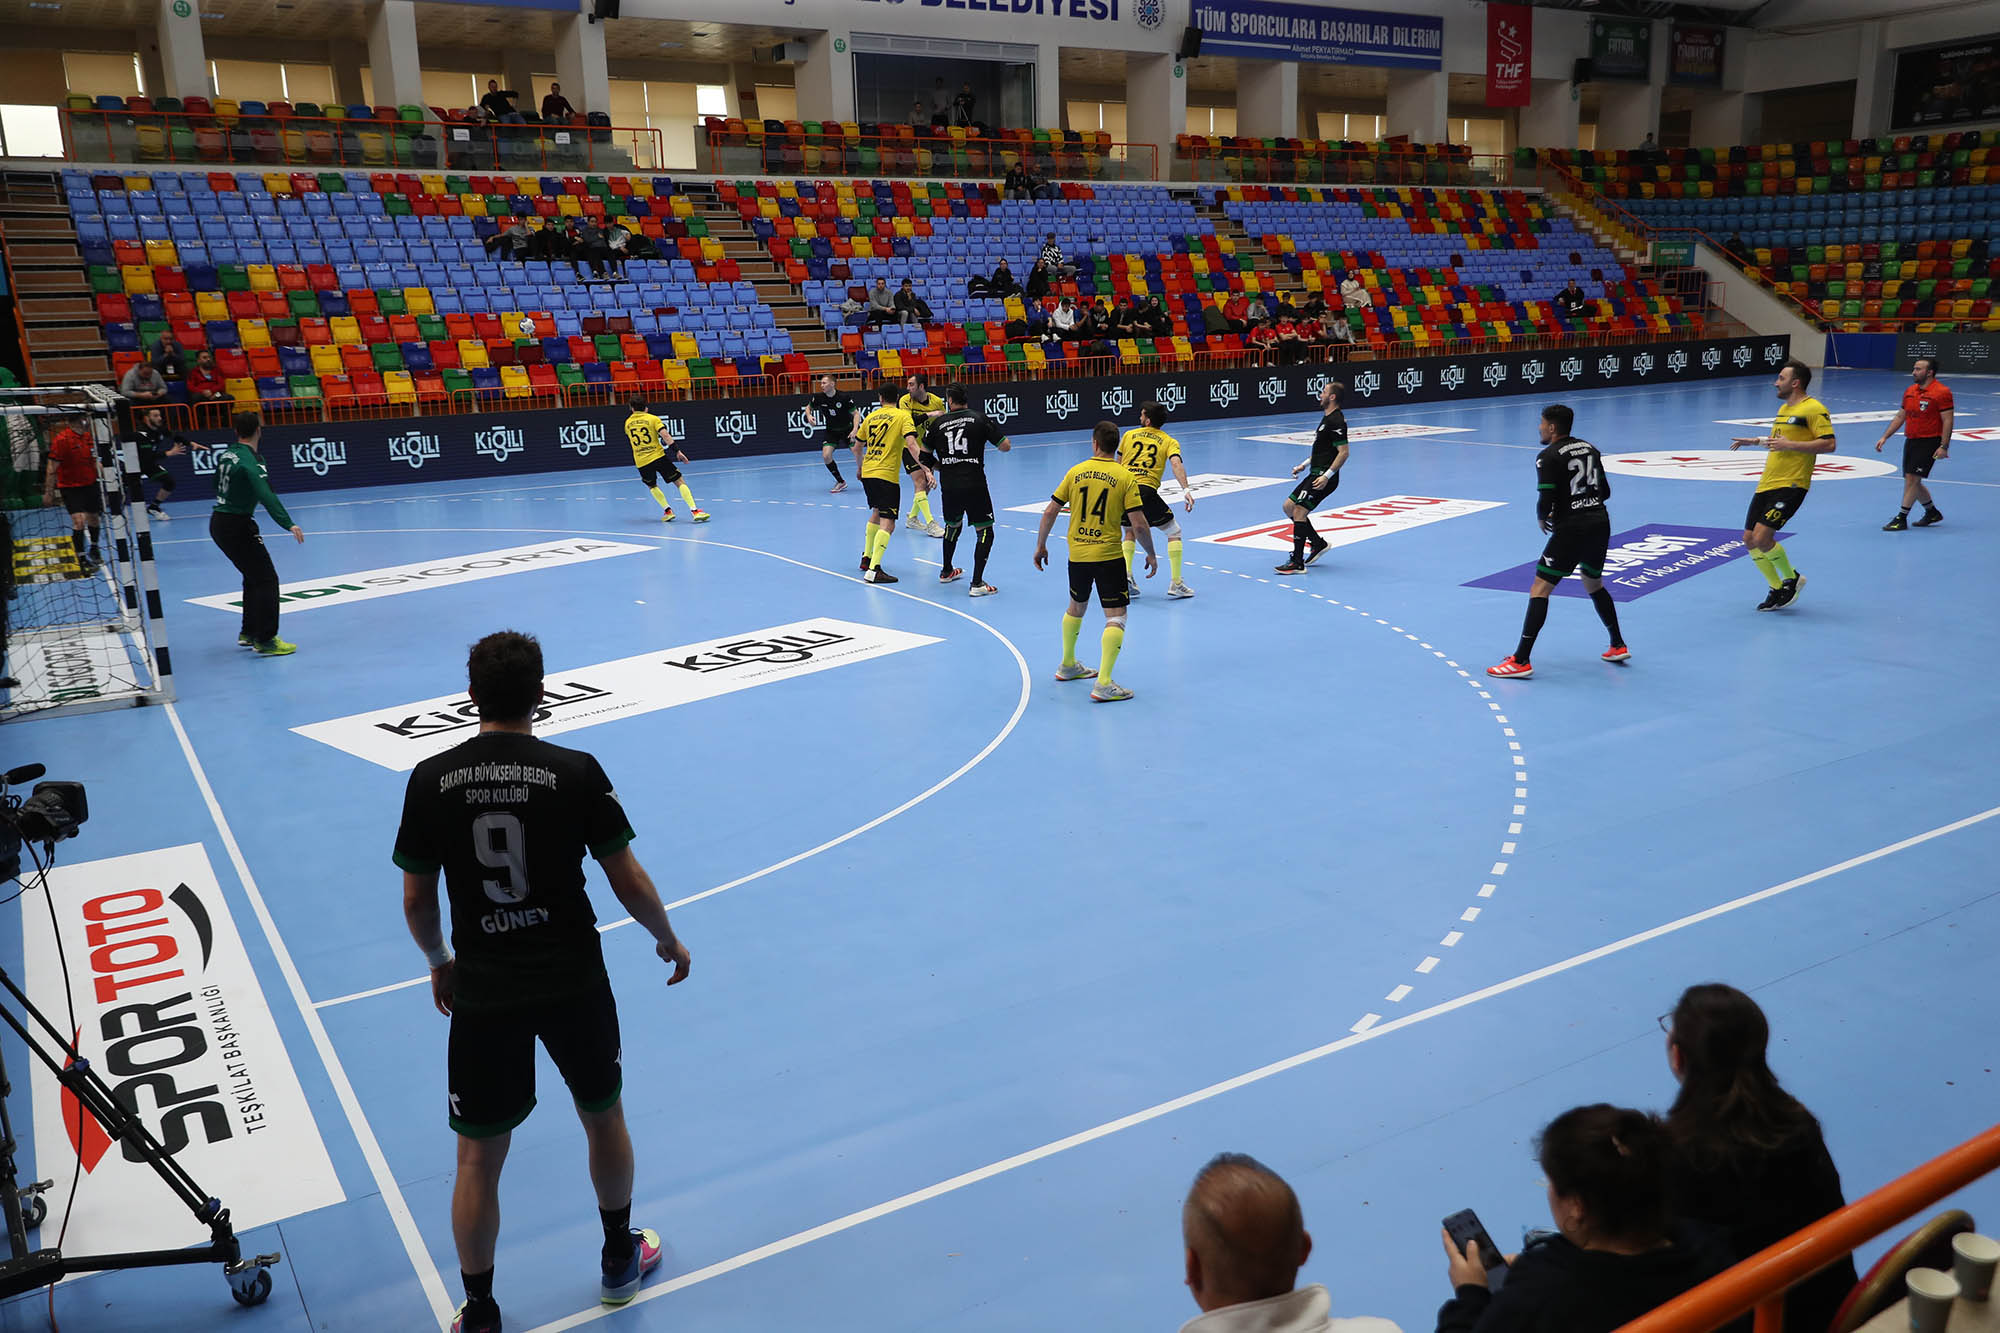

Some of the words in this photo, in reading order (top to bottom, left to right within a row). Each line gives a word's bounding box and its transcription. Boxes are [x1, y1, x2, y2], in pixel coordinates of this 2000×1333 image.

[1195, 6, 1226, 33] TÜM
[1230, 12, 1317, 40] SPORCULARA
[1320, 20, 1389, 45] BAŞARILAR
[1495, 63, 1525, 79] THF
[630, 427, 652, 446] 53
[868, 423, 886, 448] 52
[944, 428, 968, 455] 14
[1128, 441, 1157, 469] 23
[1074, 471, 1093, 484] BEYKOZ
[1567, 454, 1599, 496] 24
[1079, 486, 1109, 526] 14
[1764, 508, 1783, 522] 49
[1078, 527, 1102, 537] OLEG
[1612, 576, 1649, 589] For
[1643, 564, 1680, 578] the
[1672, 554, 1706, 571] real
[440, 765, 474, 793] SAKARYA
[474, 761, 522, 784] BÜYÜKŞEHİR
[522, 766, 558, 791] BELEDİYE
[465, 788, 491, 804] SPOR
[492, 784, 529, 804] KULÜBÜ
[471, 811, 531, 904] 9
[480, 906, 552, 935] GÜNEY
[82, 888, 185, 1004] TOTO
[200, 984, 243, 1060] BAŞKANLIĞI
[226, 1063, 267, 1135] TEŞKİLAT
